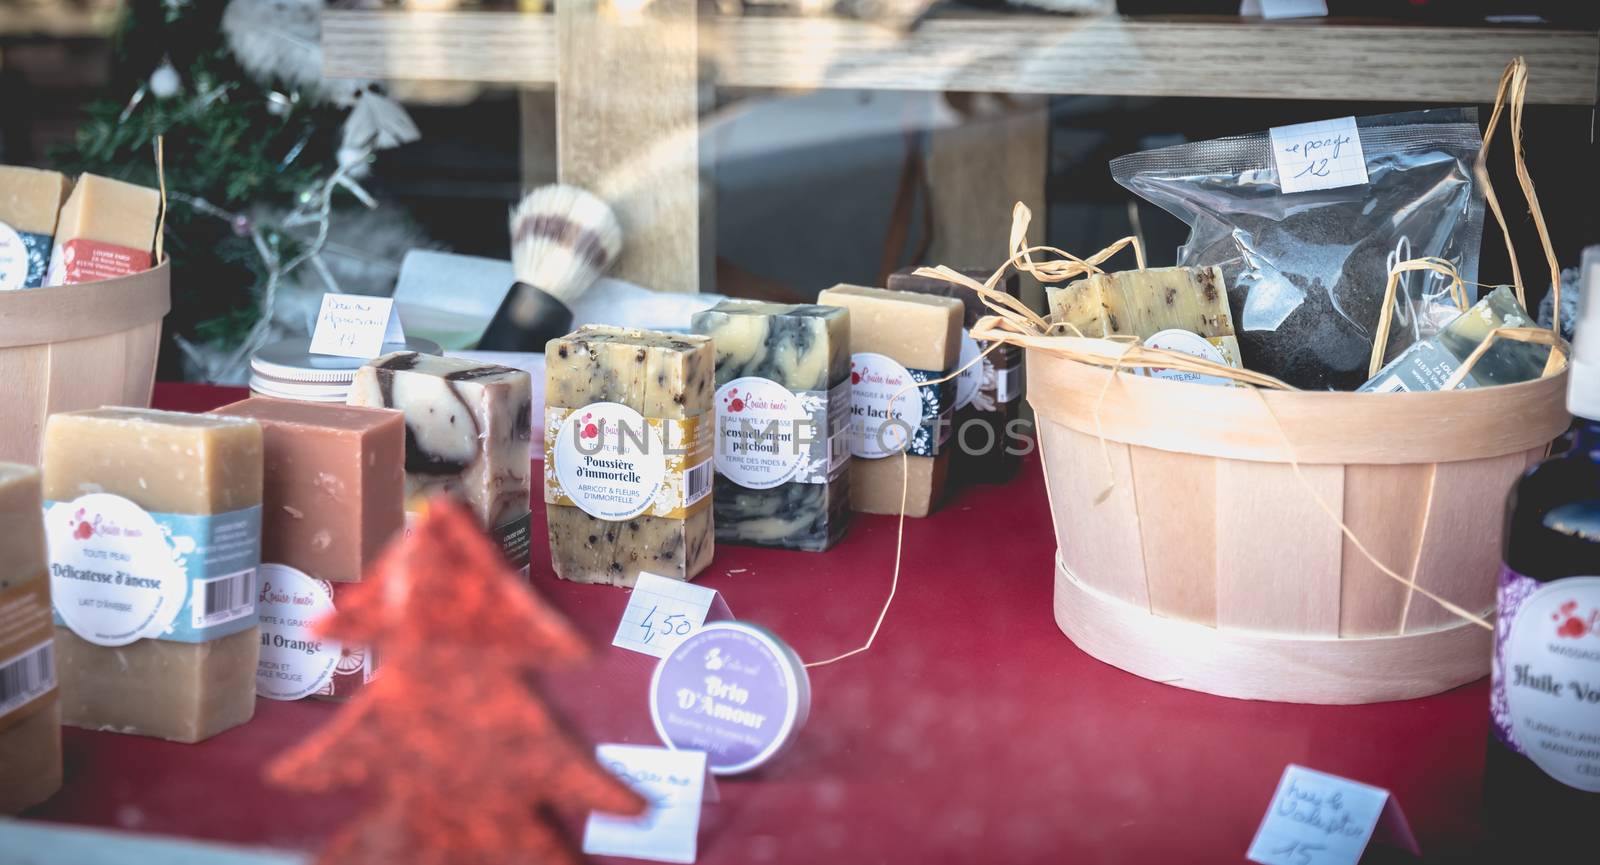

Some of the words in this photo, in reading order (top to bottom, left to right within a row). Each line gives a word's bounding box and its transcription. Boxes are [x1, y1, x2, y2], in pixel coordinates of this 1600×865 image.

[1294, 158, 1330, 178] 12
[1184, 372, 1200, 380] PEAU
[721, 426, 792, 442] Sensuellement
[733, 441, 780, 453] patchouli
[583, 456, 634, 471] Poussière
[740, 464, 770, 472] NOISETTE
[576, 466, 641, 484] d'immortelle
[578, 485, 607, 494] ABRICOT
[615, 488, 640, 497] FLEURS
[584, 493, 633, 504] D'IMMORTELLE
[82, 548, 108, 560] TOUTE
[110, 550, 132, 562] PEAU
[52, 562, 112, 584] Délicatesse
[79, 598, 94, 607] LAIT
[640, 605, 691, 644] 4,50
[274, 634, 322, 655] Orange
[276, 672, 302, 681] ROUGE
[1512, 662, 1563, 698] Huile
[704, 675, 749, 705] Brin
[676, 688, 767, 730] D'Amour
